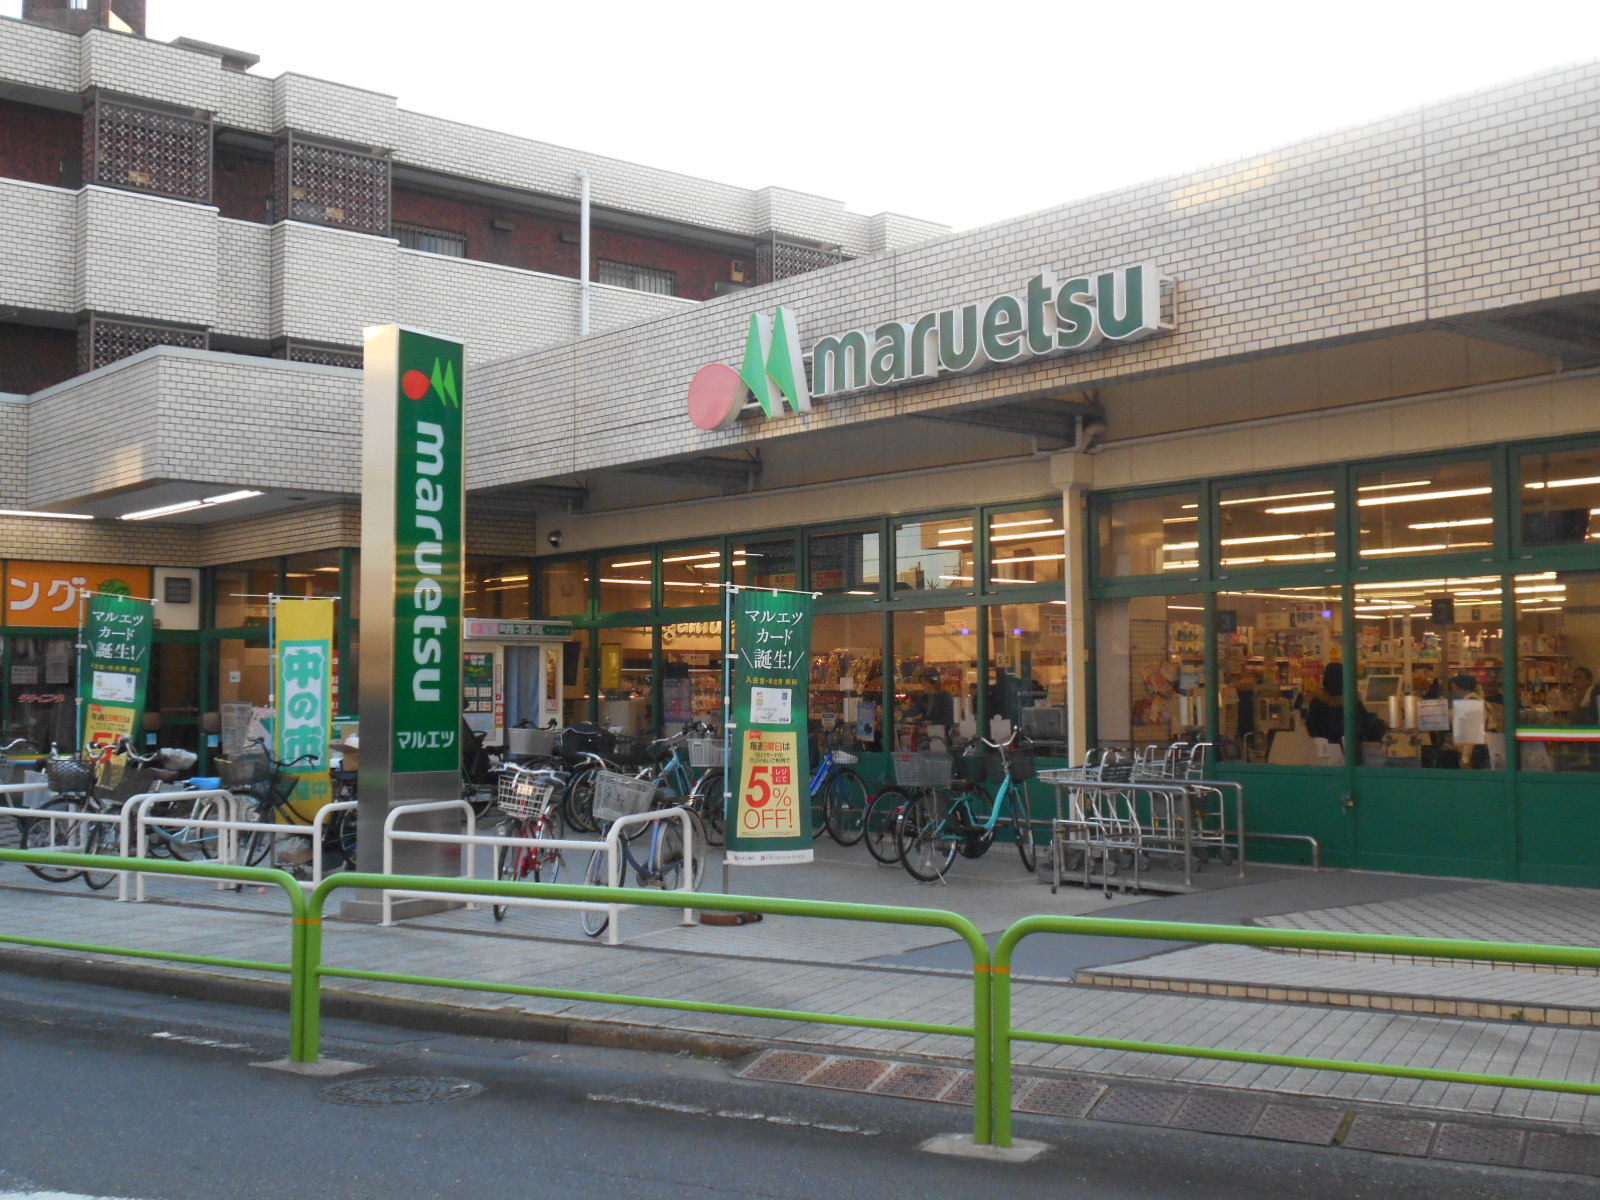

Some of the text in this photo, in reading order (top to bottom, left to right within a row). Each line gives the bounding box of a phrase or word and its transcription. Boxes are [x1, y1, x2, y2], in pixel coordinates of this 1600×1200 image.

[812, 263, 1146, 397] maruetsu
[412, 420, 448, 702] maruetsu
[92, 611, 144, 626] マルエツ
[744, 610, 803, 626] マルエツ
[98, 626, 135, 641] カード
[756, 628, 793, 646] カード
[96, 641, 135, 660] 誕生!
[753, 649, 792, 670] 誕生!
[397, 730, 454, 749] マルエツ
[743, 809, 793, 830] OFF!
